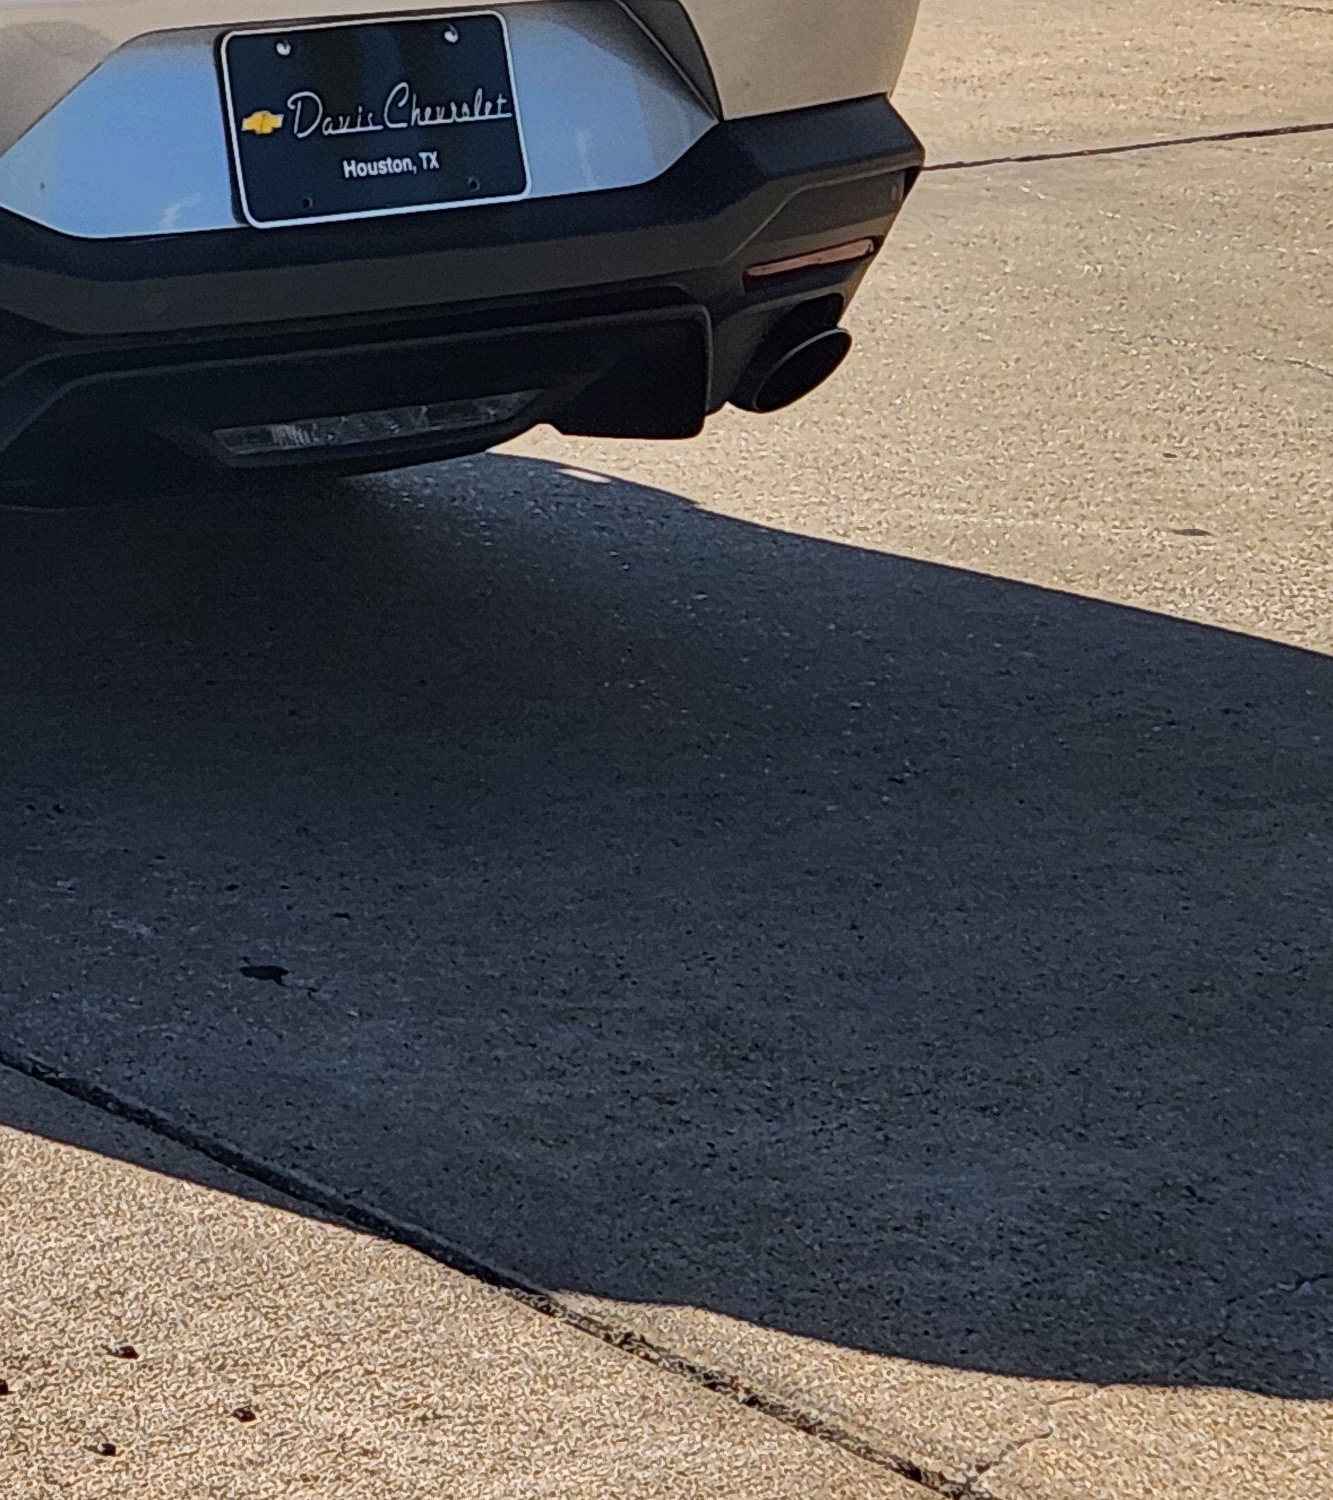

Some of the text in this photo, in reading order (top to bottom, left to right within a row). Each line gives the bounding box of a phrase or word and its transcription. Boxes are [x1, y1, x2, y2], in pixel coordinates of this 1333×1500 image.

[287, 81, 513, 138] Davis Chevrolet
[343, 151, 440, 178] Houston, TX
